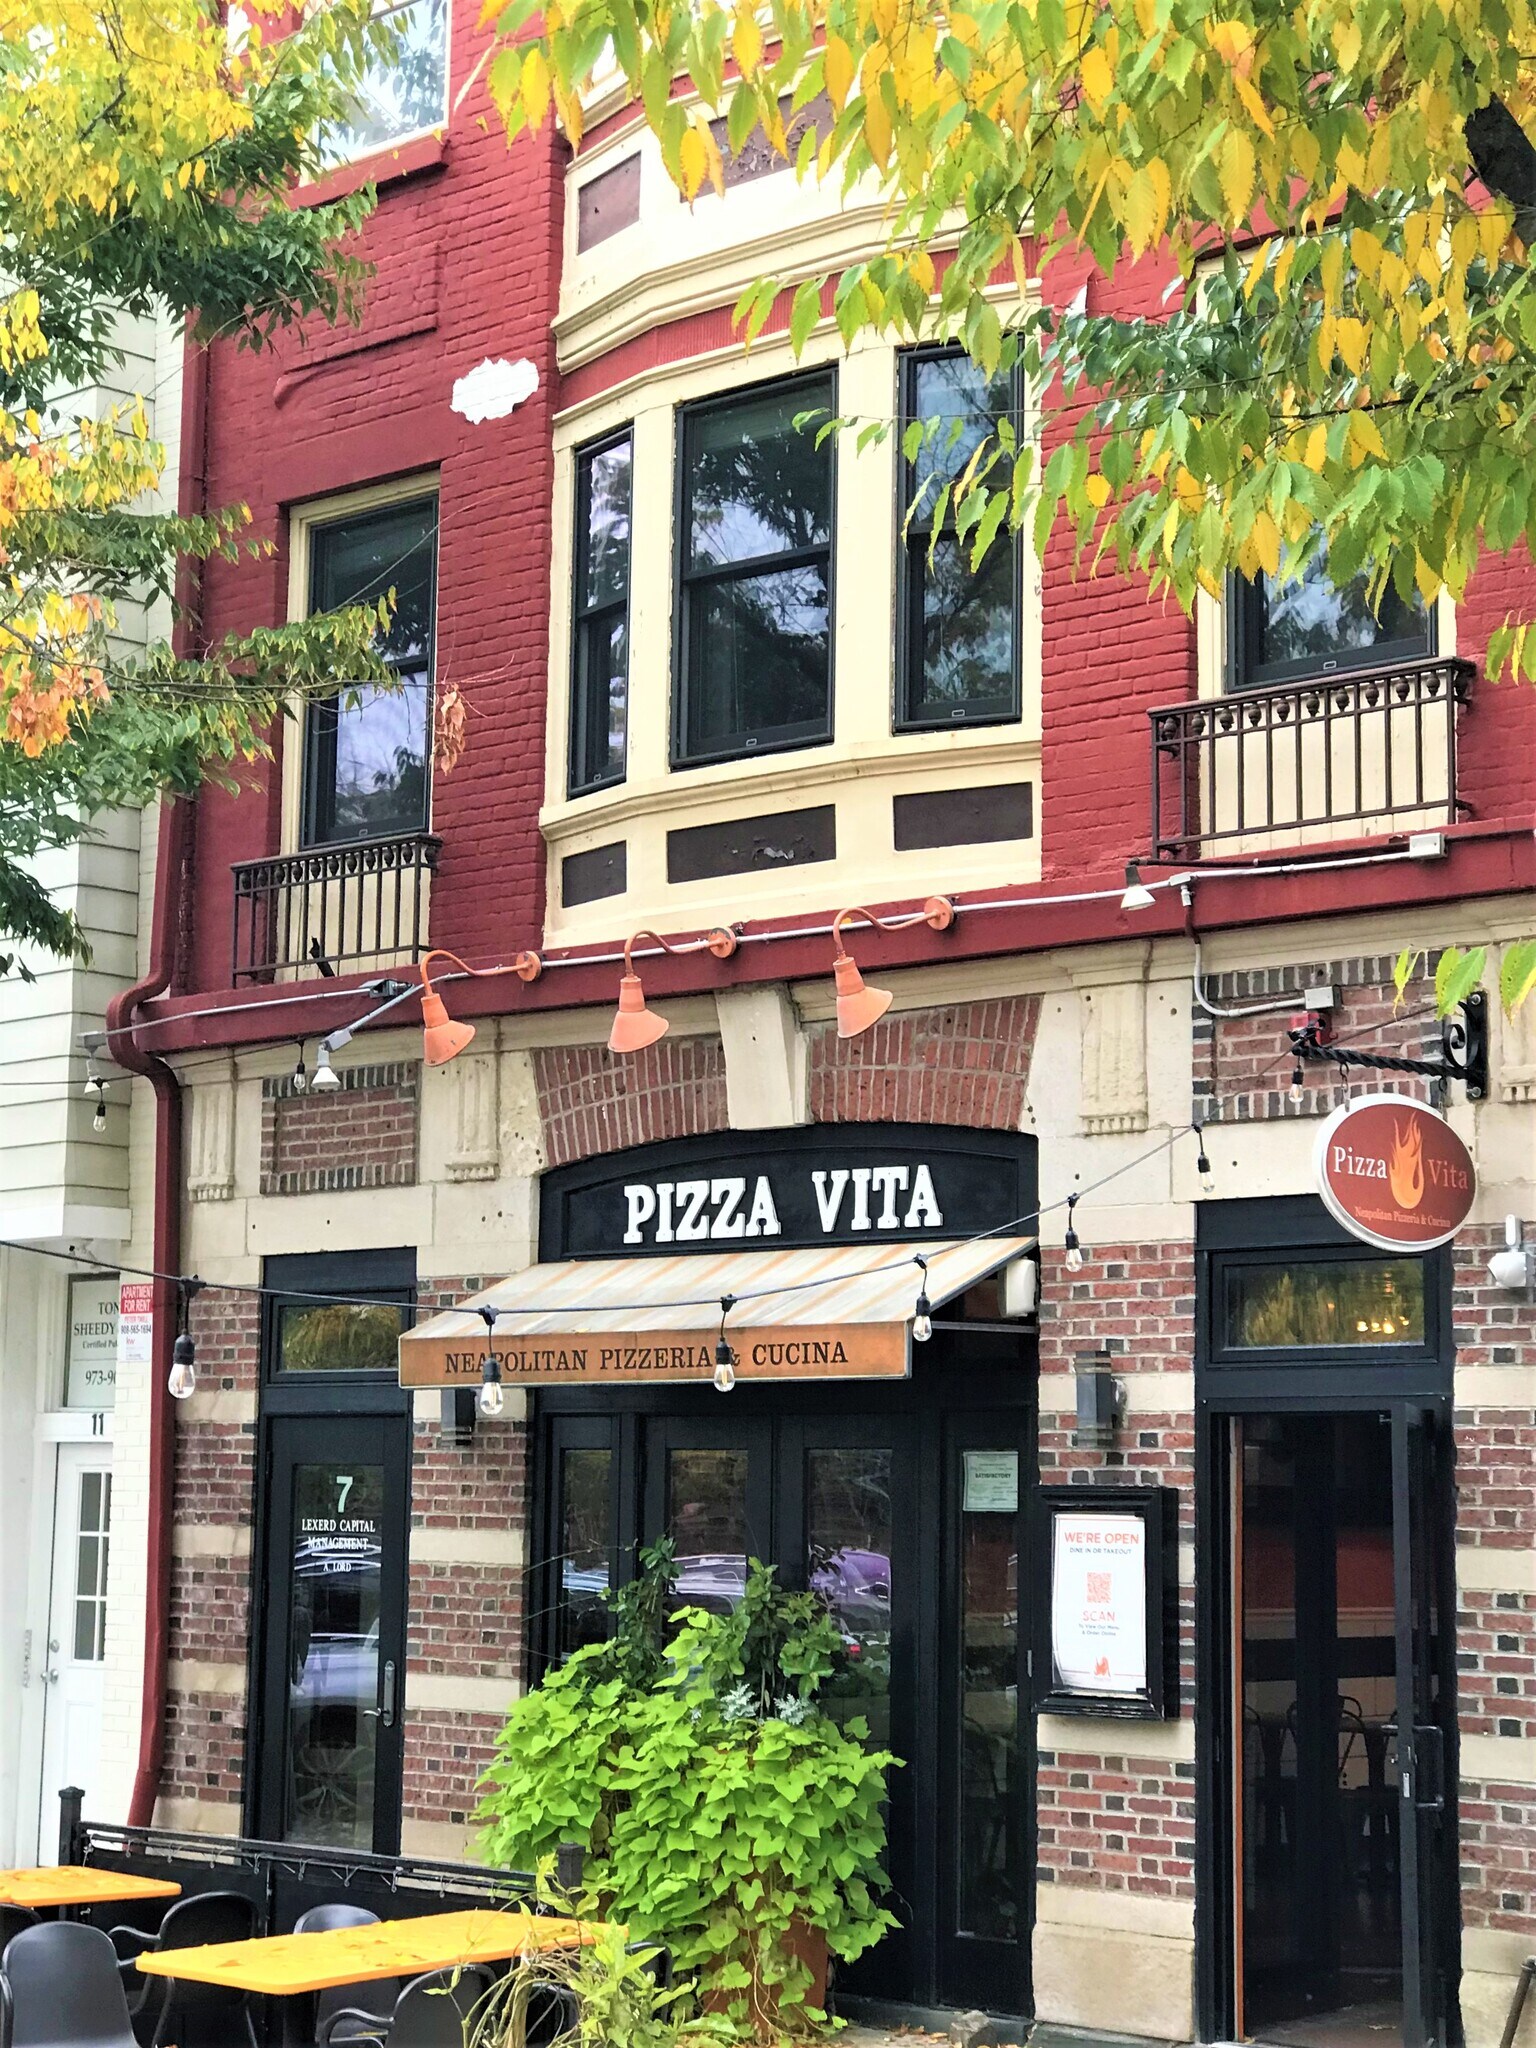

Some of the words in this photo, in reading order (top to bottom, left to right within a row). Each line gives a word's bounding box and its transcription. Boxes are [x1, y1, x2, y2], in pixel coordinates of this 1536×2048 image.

[1333, 1146, 1388, 1179] Pizza
[1428, 1159, 1468, 1190] Vita
[623, 1176, 781, 1244] PIZZA
[811, 1164, 943, 1233] VITA
[124, 1300, 135, 1313] FOR
[135, 1299, 150, 1312] RENT
[74, 1322, 115, 1336] SHEEDY
[82, 1339, 107, 1349] Certified
[445, 1350, 588, 1373] NEAPOLITAN
[600, 1346, 712, 1370] PIZZERIA
[752, 1342, 848, 1366] CUCINA
[92, 1413, 104, 1435] 11
[336, 1476, 353, 1513] 7
[302, 1519, 336, 1531] LEXERD
[339, 1520, 375, 1532] CAPITAL
[308, 1537, 368, 1550] MANAGEMENT
[1064, 1532, 1101, 1544] WE'RE
[1104, 1533, 1139, 1544] OPEN
[333, 1562, 351, 1572] LORD
[1083, 1610, 1115, 1622] SCAN
